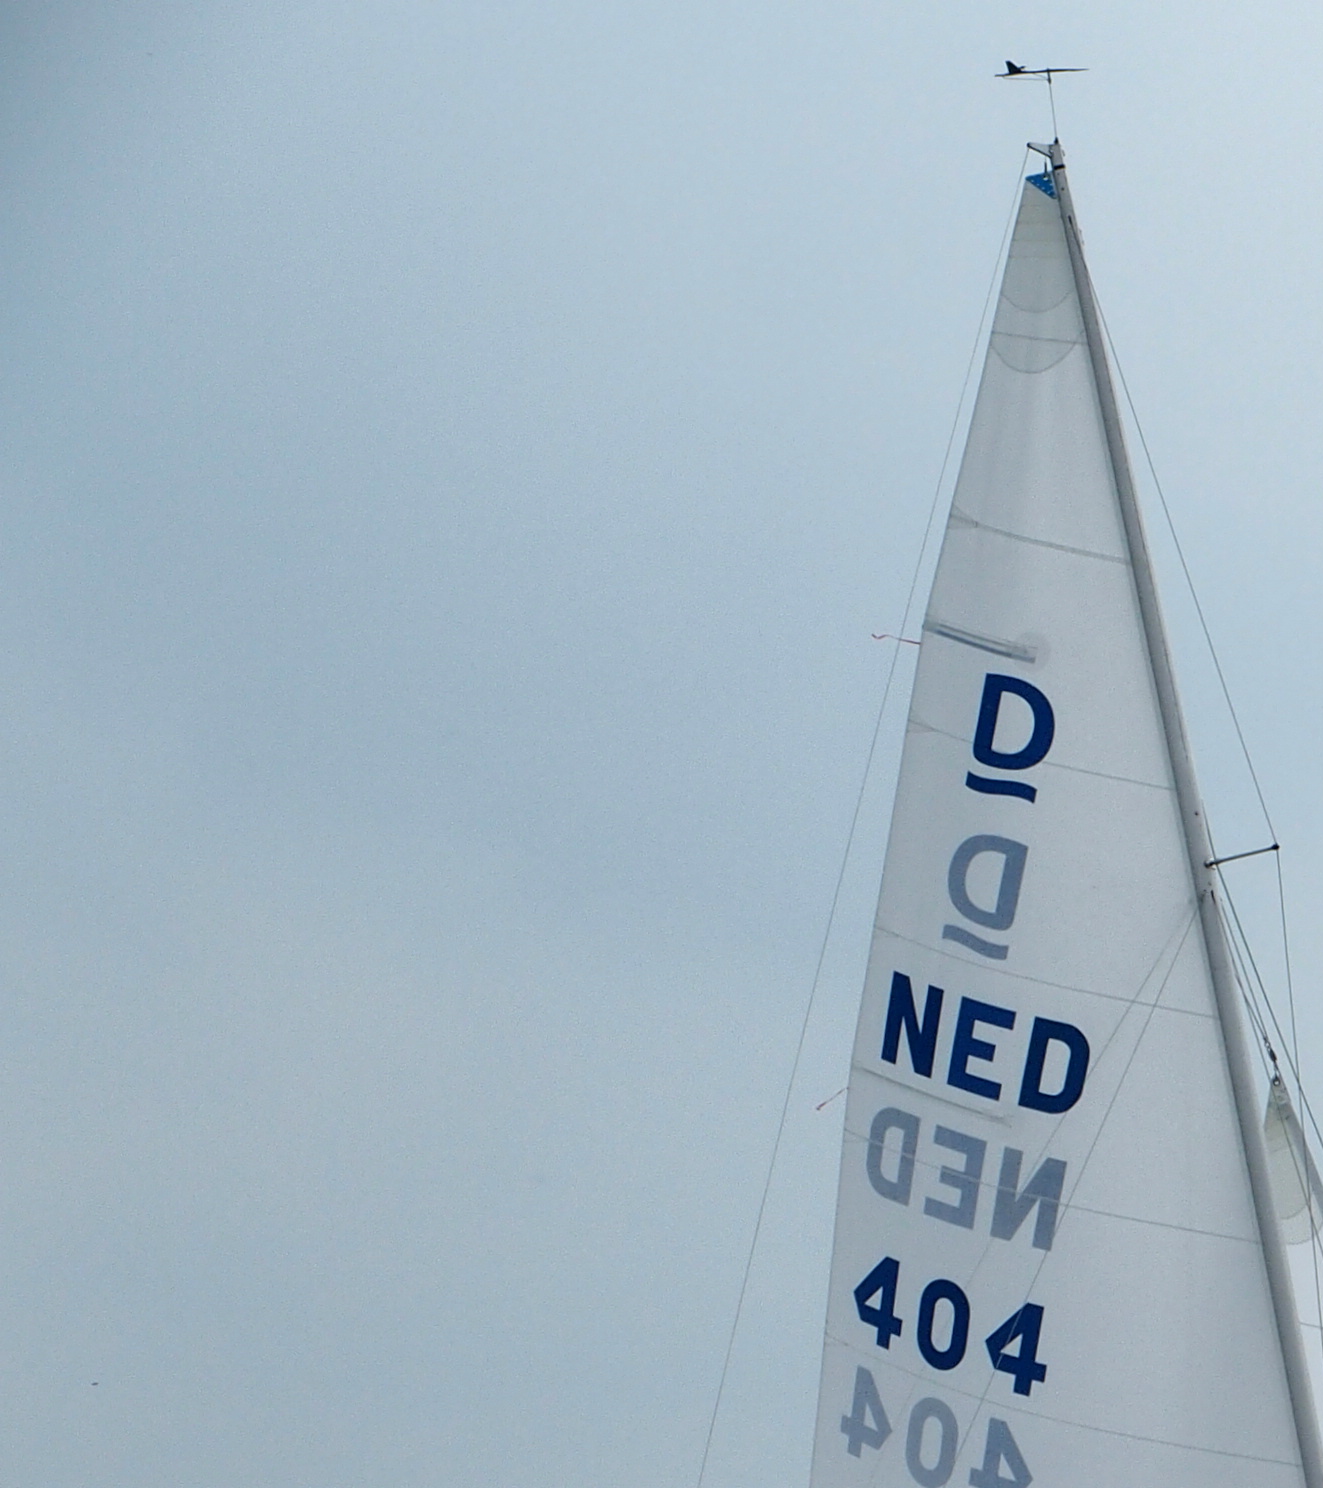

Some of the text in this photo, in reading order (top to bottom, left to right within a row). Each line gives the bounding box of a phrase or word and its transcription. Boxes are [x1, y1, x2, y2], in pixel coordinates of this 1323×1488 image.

[973, 673, 1054, 770] D
[881, 971, 1089, 1113] NED
[854, 1257, 1046, 1396] 404
